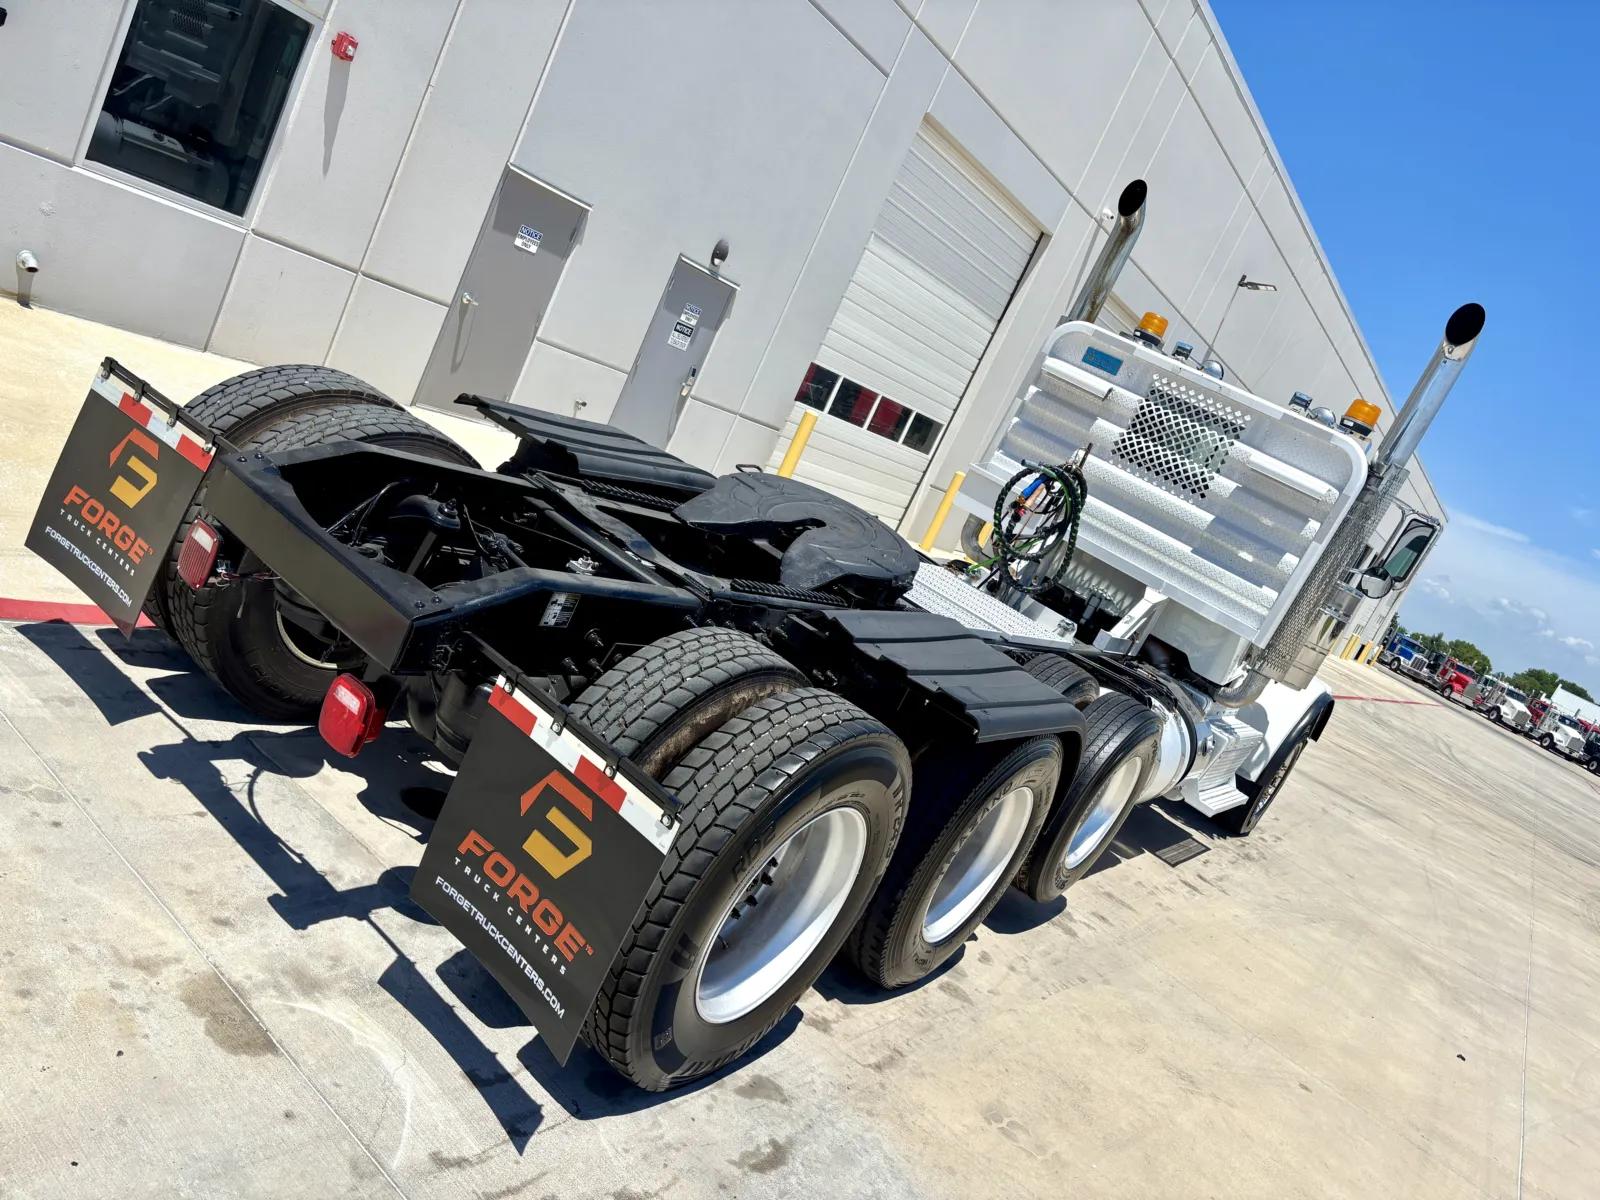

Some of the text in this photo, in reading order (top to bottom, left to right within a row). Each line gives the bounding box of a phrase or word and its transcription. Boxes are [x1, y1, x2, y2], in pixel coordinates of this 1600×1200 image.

[521, 226, 541, 240] NOTICE
[675, 323, 692, 336] NOTICE
[45, 525, 133, 608] FORGETRUCKCENTERS.COM
[60, 508, 135, 577] TRUCK CENTERS
[435, 875, 565, 1020] FORGETRUCKCENTERS.COM
[454, 857, 567, 976] TRUCK CENTERS
